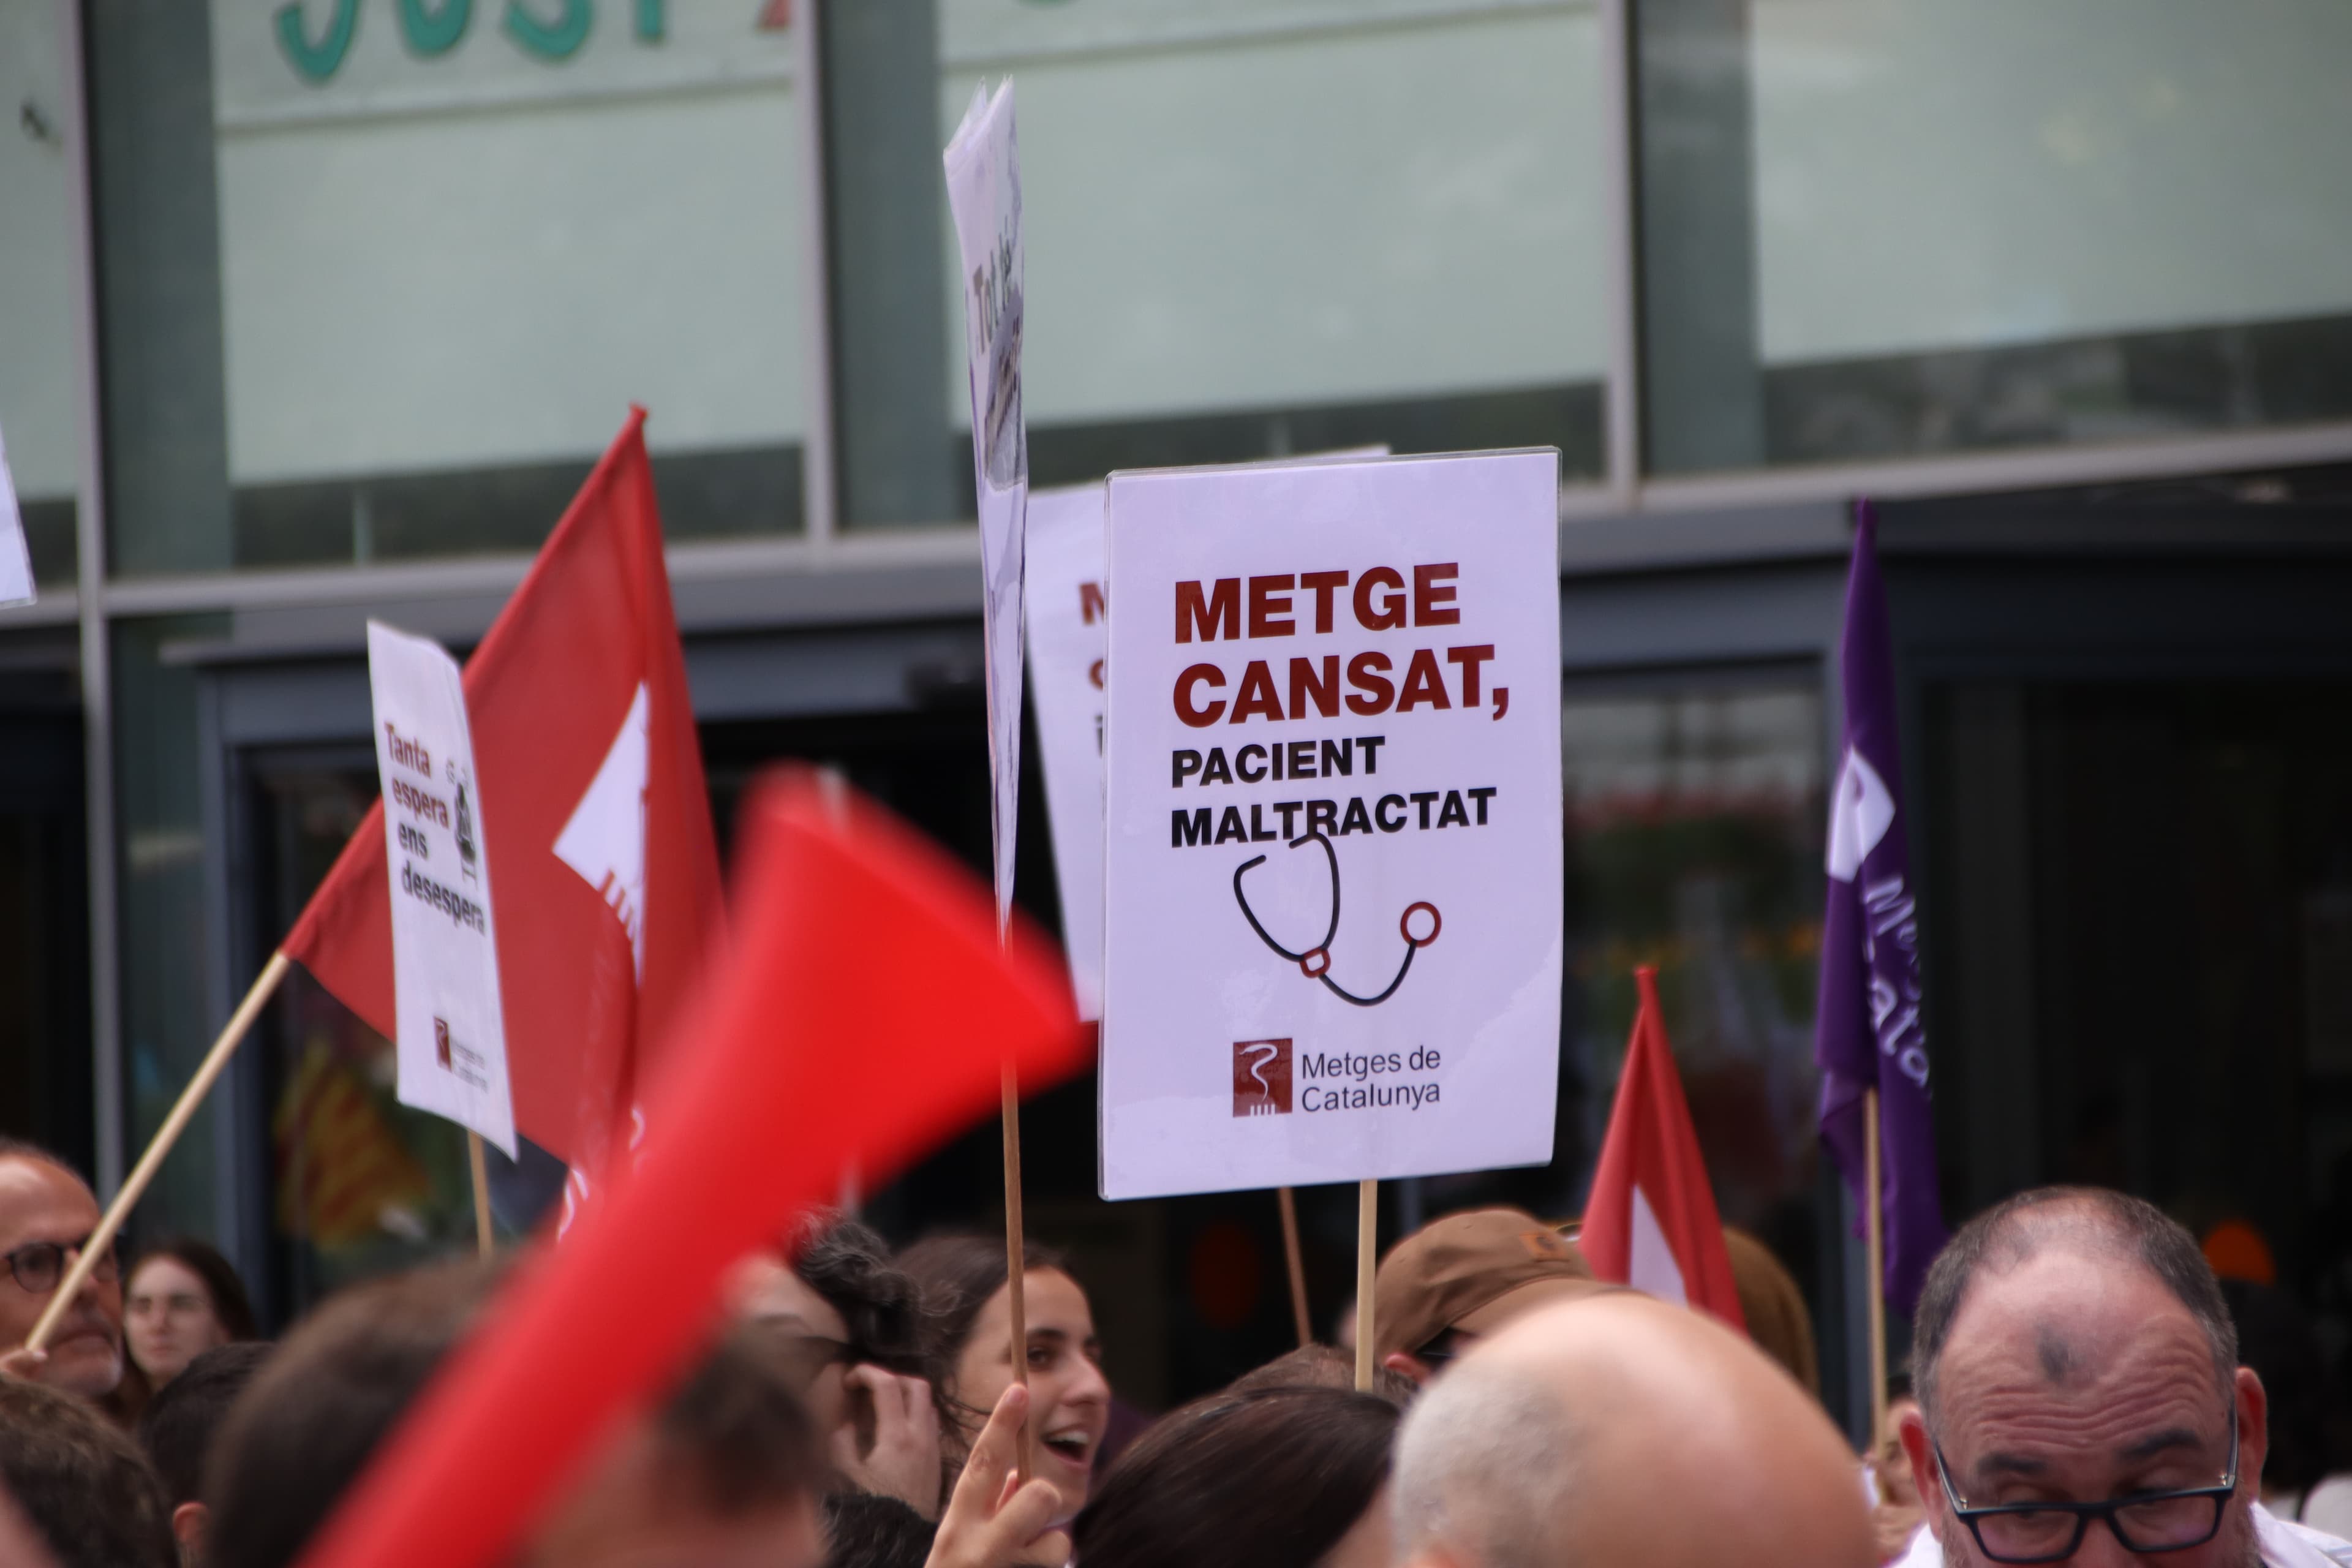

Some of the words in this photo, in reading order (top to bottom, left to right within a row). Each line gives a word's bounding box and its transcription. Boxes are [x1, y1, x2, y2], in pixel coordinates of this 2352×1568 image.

[1175, 562, 1461, 644] METGE
[1173, 644, 1509, 728] CANSAT,
[384, 722, 431, 778] Tanta
[1172, 736, 1385, 788] PACIENT
[392, 777, 450, 829] espera
[1171, 786, 1498, 848] MALTRACTAT
[398, 822, 428, 860] ens
[402, 859, 486, 936] desespera
[1302, 1052, 1401, 1082] Metges
[1409, 1045, 1441, 1071] de
[1301, 1082, 1441, 1112] Catalunya
